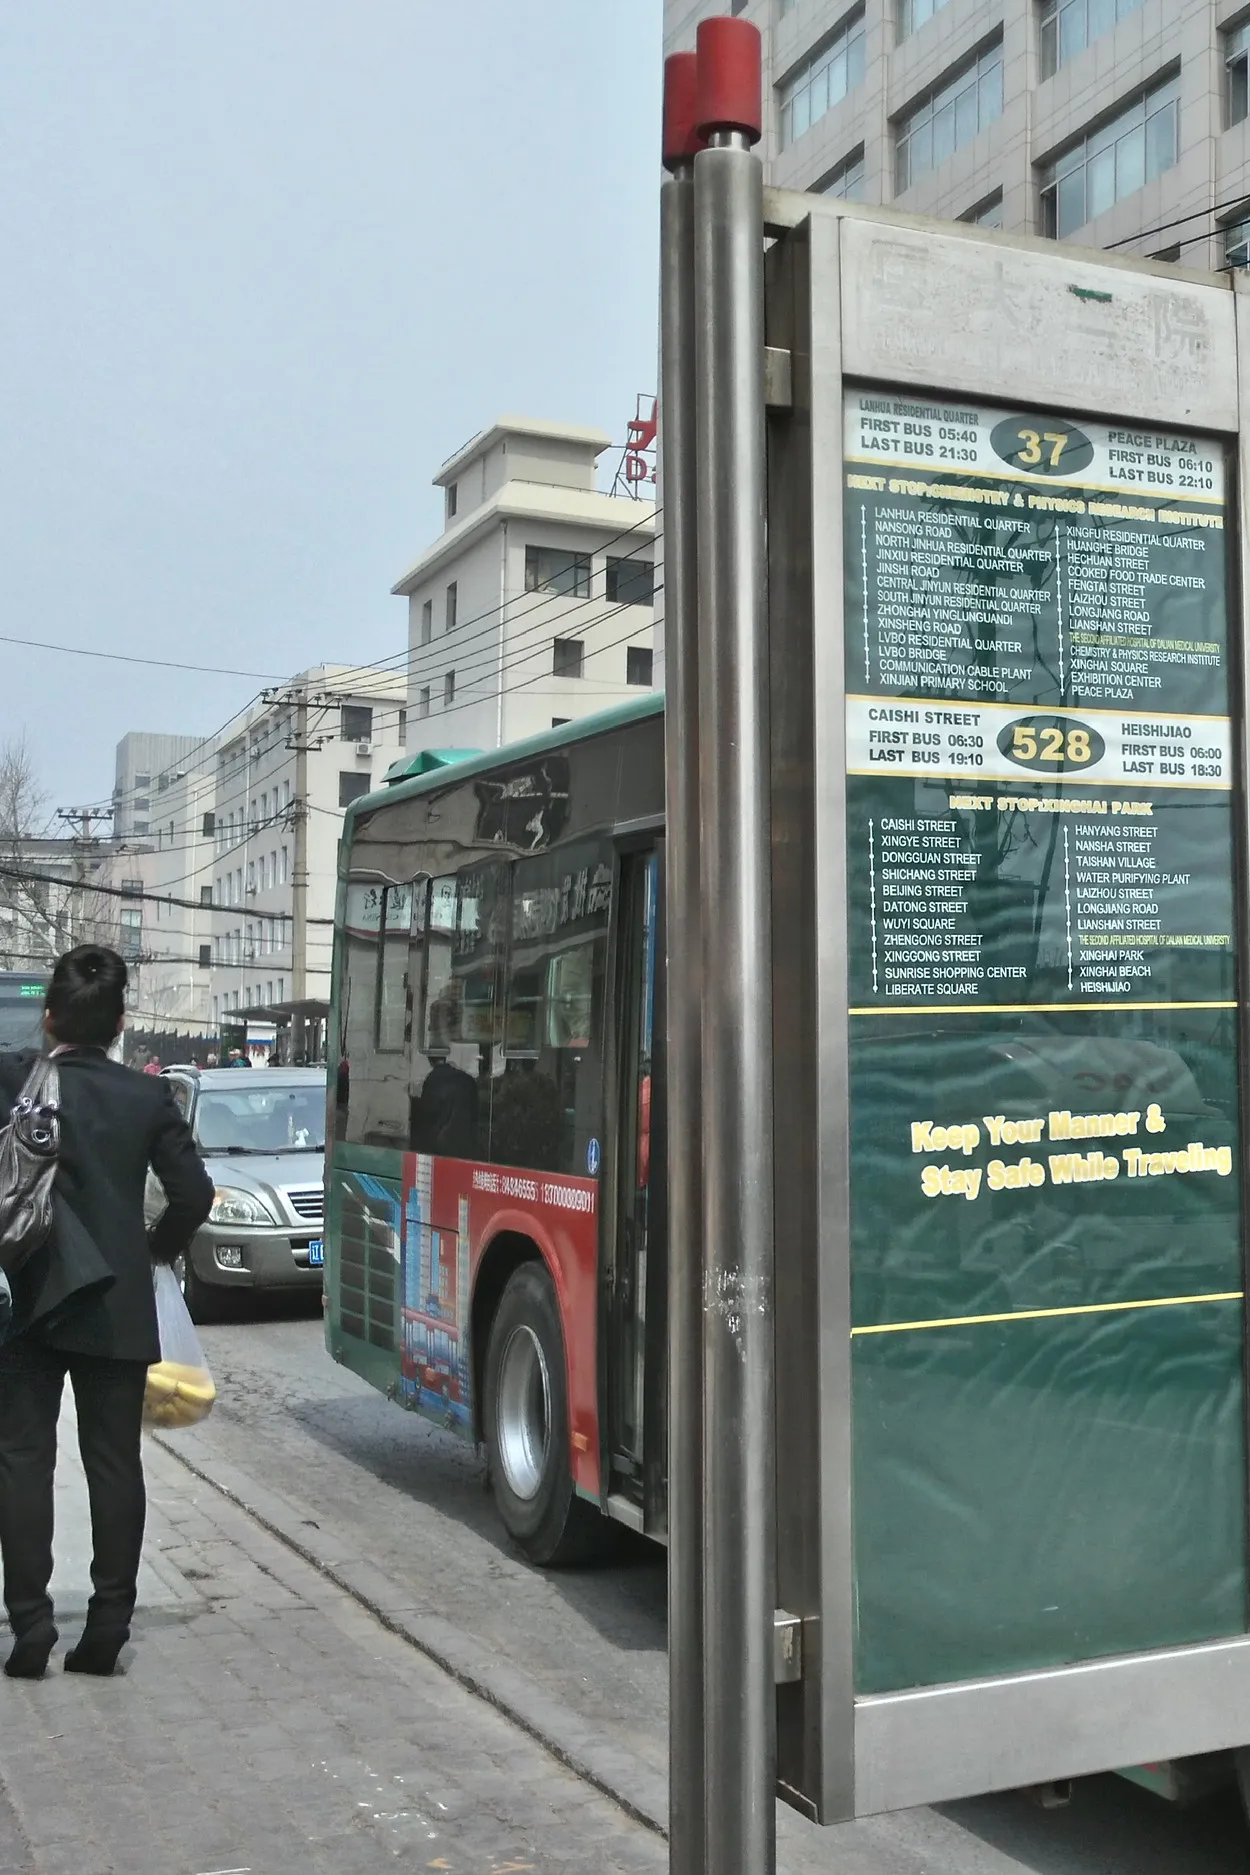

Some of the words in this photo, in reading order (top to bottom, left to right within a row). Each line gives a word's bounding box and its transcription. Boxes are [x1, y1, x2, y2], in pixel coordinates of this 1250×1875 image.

[860, 399, 890, 415] LANHUA
[893, 403, 940, 421] RESIDENTIAL
[943, 409, 978, 425] QUARTER
[861, 417, 899, 435] FIRST
[904, 421, 931, 438] BUS
[939, 425, 977, 443] 05:40
[861, 434, 899, 453] LAST
[904, 439, 933, 457] BUS
[939, 444, 977, 462] 21:30
[1017, 427, 1068, 468] 37
[1108, 432, 1151, 449] PEACE
[1155, 436, 1196, 453] PLAZA
[626, 455, 656, 483] D
[1109, 450, 1143, 466] FIRST
[1147, 453, 1170, 469] BUS
[1178, 456, 1212, 473] 06:10
[1110, 467, 1143, 483] LAST
[1147, 470, 1173, 486] BUS
[1179, 473, 1212, 490] 22:10
[875, 507, 915, 522] LANHUA
[918, 511, 981, 528] RESIDENTIAL
[984, 517, 1029, 533] QUARTER
[875, 521, 922, 537] NANSONG
[925, 525, 951, 539] ROAD
[1067, 526, 1100, 541] XINGFU
[1102, 529, 1160, 546] RESIDENTIAL
[1162, 534, 1204, 550] QUARTER
[1067, 539, 1112, 554] HUANGHE
[1114, 543, 1148, 557] BRIDGE
[877, 549, 907, 563] JINXIU
[910, 552, 974, 568] RESIDENTIAL
[976, 557, 1023, 572] QUARTER
[1068, 553, 1111, 567] HECHUAN
[1114, 556, 1148, 570] STREET
[877, 562, 908, 576] JINSHI
[911, 565, 939, 578] ROAD
[1068, 565, 1106, 580] COOKED
[1110, 569, 1134, 582] FOOD
[1137, 571, 1166, 585] TRADE
[1169, 574, 1204, 588] CENTER
[1069, 579, 1106, 593] FENGTAI
[1109, 582, 1144, 596] STREET
[1069, 592, 1107, 606] LAIZHOU
[1110, 595, 1145, 608] STREET
[878, 604, 930, 619] ZHONGHAI
[1069, 606, 1121, 620] LONGJIANG
[1123, 609, 1149, 622] ROAD
[878, 617, 930, 632] XINSHENG
[933, 621, 961, 634] ROAD
[1070, 618, 1114, 633] LIANSHAN
[1117, 622, 1152, 635] STREET
[879, 632, 905, 645] LVBO
[908, 634, 971, 649] RESIDENTIAL
[974, 638, 1021, 652] QUARTER
[879, 645, 905, 658] LVBO
[908, 647, 946, 661] BRIDGE
[880, 659, 964, 675] COMMUNICATION
[967, 664, 999, 677] CABLE
[1001, 666, 1031, 679] PLANT
[1071, 659, 1108, 672] XINGHAI
[1111, 661, 1148, 674] SQUARE
[880, 673, 917, 686] XINJIAN
[920, 675, 965, 689] PRIMARY
[967, 678, 1007, 692] SCHOOL
[1071, 672, 1122, 686] EXHIBITION
[1124, 675, 1161, 688] CENTER
[1072, 685, 1101, 698] PEACE
[1104, 687, 1133, 699] PLAZA
[869, 708, 918, 724] CAISHI
[925, 711, 980, 727] STREET
[869, 730, 908, 746] FIRST
[912, 732, 940, 747] BUS
[948, 733, 983, 748] 06:30
[1122, 723, 1191, 739] HEISHIJIAO
[1011, 726, 1091, 762] 528
[1122, 744, 1156, 758] FIRST
[1159, 745, 1184, 759] BUS
[1190, 746, 1221, 760] 06:00
[869, 748, 904, 763] LAST
[912, 750, 939, 765] BUS
[949, 751, 983, 766] 19:10
[1123, 761, 1153, 775] LAST
[1160, 762, 1184, 776] BUS
[1191, 763, 1221, 777] 18:30
[881, 819, 914, 832] CAISHI
[917, 819, 956, 833] STREET
[1076, 825, 1120, 838] HANYANG
[1122, 826, 1157, 838] STREET
[882, 835, 919, 849] XINGYE
[922, 836, 960, 849] STREET
[1076, 840, 1113, 853] NANSHA
[1116, 841, 1150, 853] STREET
[882, 852, 940, 865] DONGGUAN
[943, 853, 981, 866] STREET
[1076, 855, 1115, 868] TAISHAN
[1118, 856, 1155, 869] VILLAGE
[883, 868, 935, 881] SHICHANG
[938, 869, 976, 882] STREET
[1077, 872, 1109, 884] WATER
[1112, 872, 1160, 885] PURIFYING
[1162, 873, 1190, 885] PLANT
[883, 885, 921, 897] BEIJING
[925, 885, 962, 898] STREET
[1077, 887, 1116, 899] LAIZHOU
[1118, 888, 1153, 900] STREET
[883, 901, 926, 914] DATONG
[929, 901, 967, 914] STREET
[1078, 902, 1130, 915] LONGJIANG
[1132, 903, 1158, 915] ROAD
[883, 917, 909, 930] WUYI
[912, 917, 955, 930] SQUARE
[1078, 918, 1123, 930] LIANSHAN
[1126, 919, 1160, 931] STREET
[884, 934, 941, 946] ZHENGONG
[944, 934, 982, 946] STREET
[884, 950, 939, 962] XINGGONG
[942, 950, 980, 962] STREET
[1080, 949, 1117, 961] XINGHAI
[1119, 950, 1143, 961] PARK
[885, 966, 930, 979] SUNRISE
[933, 966, 983, 979] SHOPPING
[987, 966, 1026, 978] CENTER
[1080, 965, 1117, 977] XINGHAI
[1119, 965, 1150, 977] BEACH
[885, 983, 933, 995] LIBERATE
[937, 982, 978, 995] SQUARE
[1081, 981, 1130, 993] HEISHIJIAO
[911, 1121, 979, 1155] Keep
[983, 1116, 1044, 1145] Your
[1049, 1111, 1139, 1141] Manner
[1146, 1103, 1166, 1134] &
[921, 1165, 981, 1200] Stay
[987, 1157, 1044, 1190] Safe
[1049, 1152, 1119, 1184] While
[1123, 1143, 1232, 1177] Traveling
